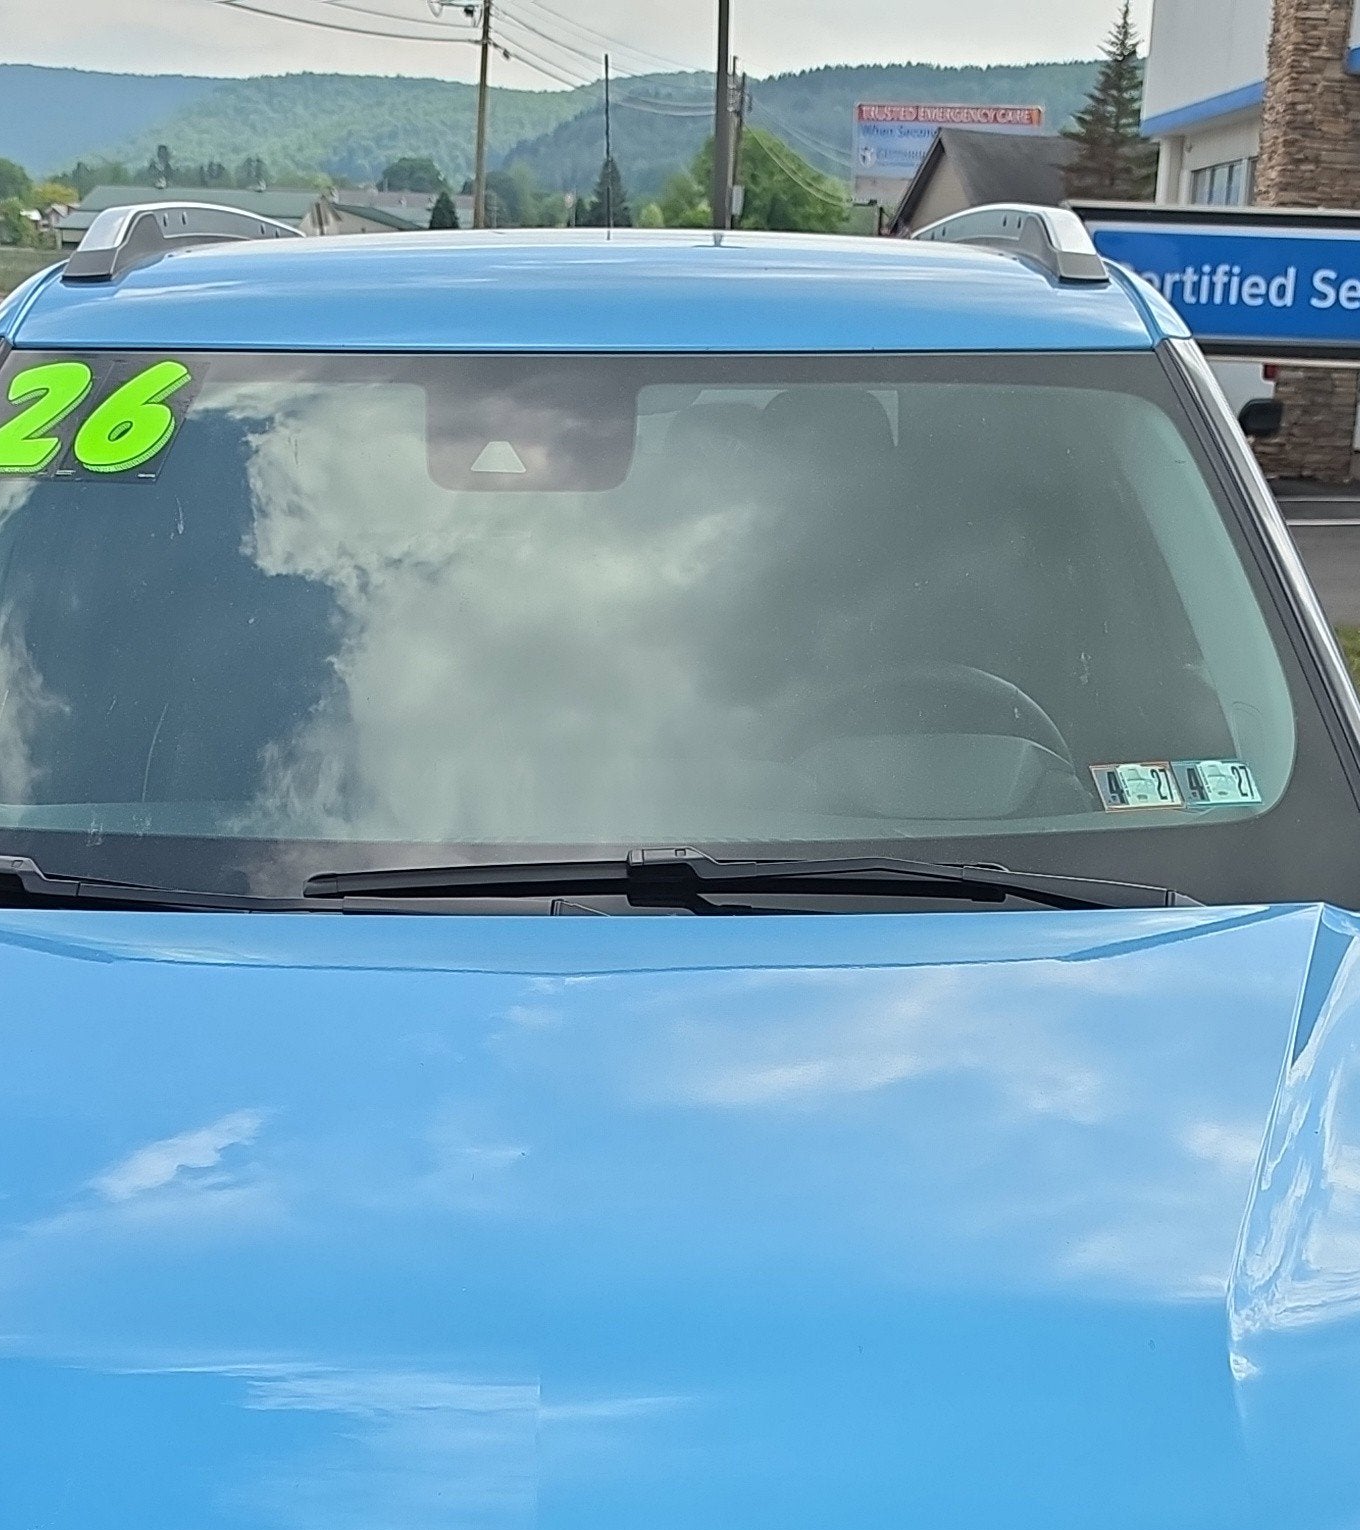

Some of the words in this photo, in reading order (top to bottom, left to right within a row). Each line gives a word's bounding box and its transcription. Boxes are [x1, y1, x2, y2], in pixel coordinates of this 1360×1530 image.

[862, 105, 917, 121] TRUSTED
[918, 107, 995, 123] EMERGENCY
[997, 109, 1032, 124] CARE
